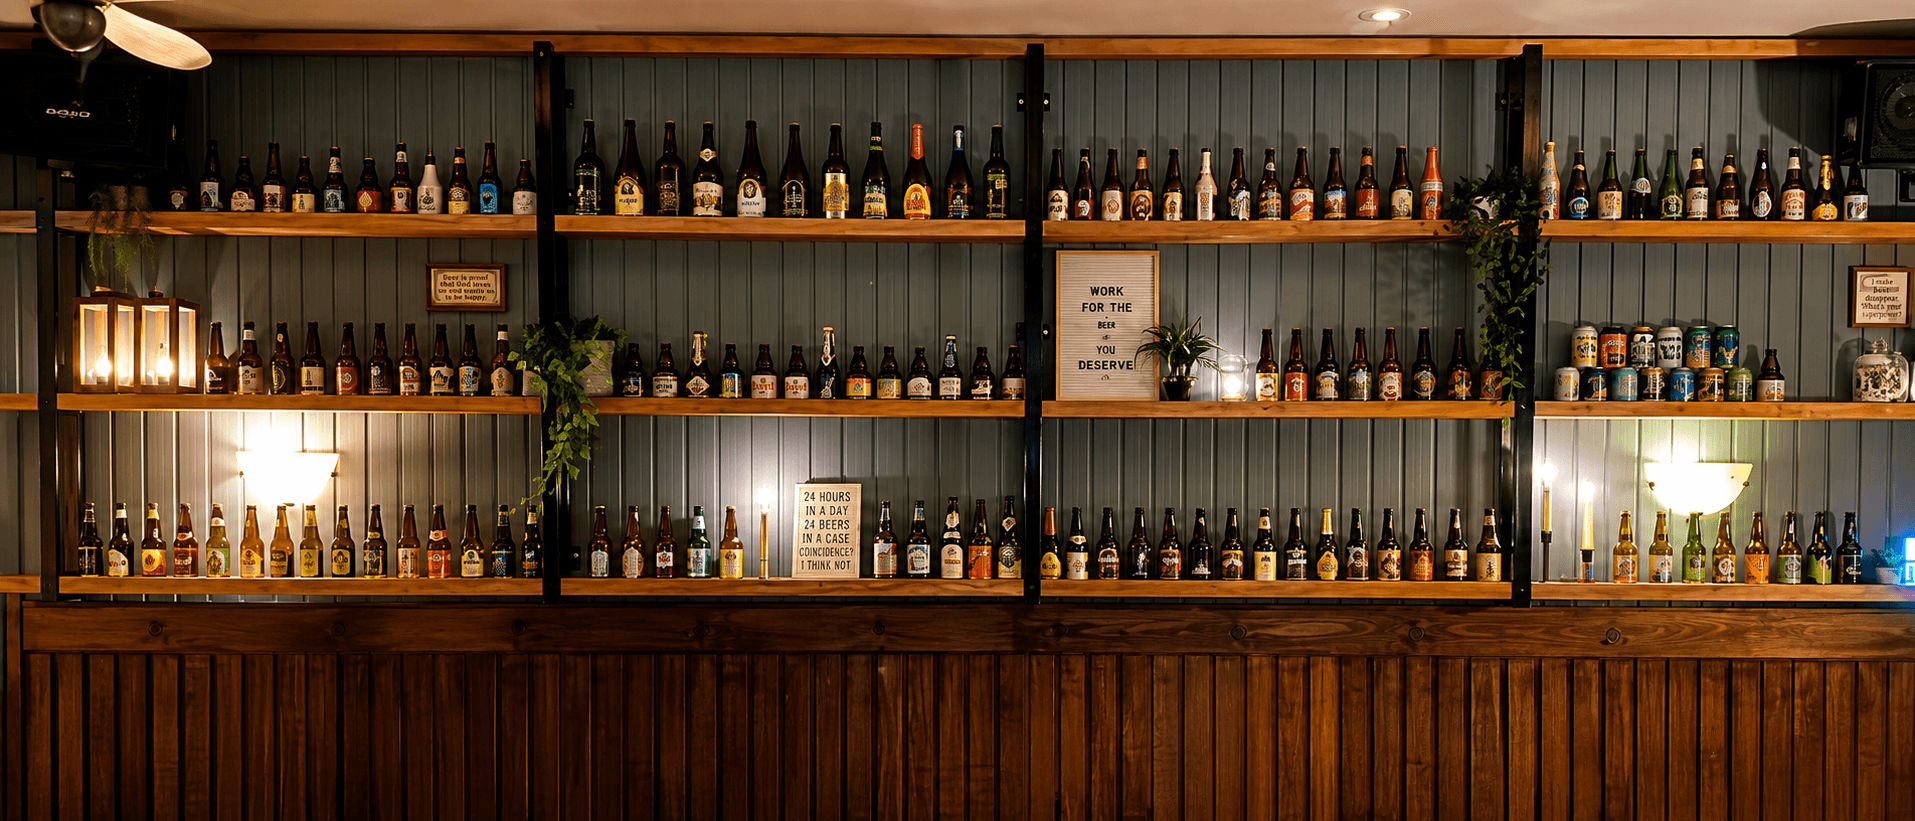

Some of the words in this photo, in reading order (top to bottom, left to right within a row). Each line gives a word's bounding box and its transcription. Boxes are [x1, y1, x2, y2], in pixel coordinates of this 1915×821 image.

[1090, 287, 1124, 296] WORK
[1082, 303, 1104, 312] FOR
[1109, 303, 1132, 312] THE
[1097, 321, 1116, 329] BEER
[1096, 346, 1116, 354] YOU
[1078, 361, 1133, 370] DESERVE
[804, 491, 816, 502] 24
[819, 491, 851, 502] HOURS
[806, 506, 816, 515] IN
[819, 506, 826, 515] A
[829, 506, 849, 516] DAY
[804, 519, 815, 530] 24
[819, 519, 850, 530] BEERS
[802, 533, 813, 543] IN
[816, 533, 822, 543] A
[825, 533, 850, 543] CASE
[799, 547, 854, 557] COINCIDENCE?
[801, 560, 805, 570] I
[807, 560, 831, 570] THINK
[834, 560, 852, 570] NOT
